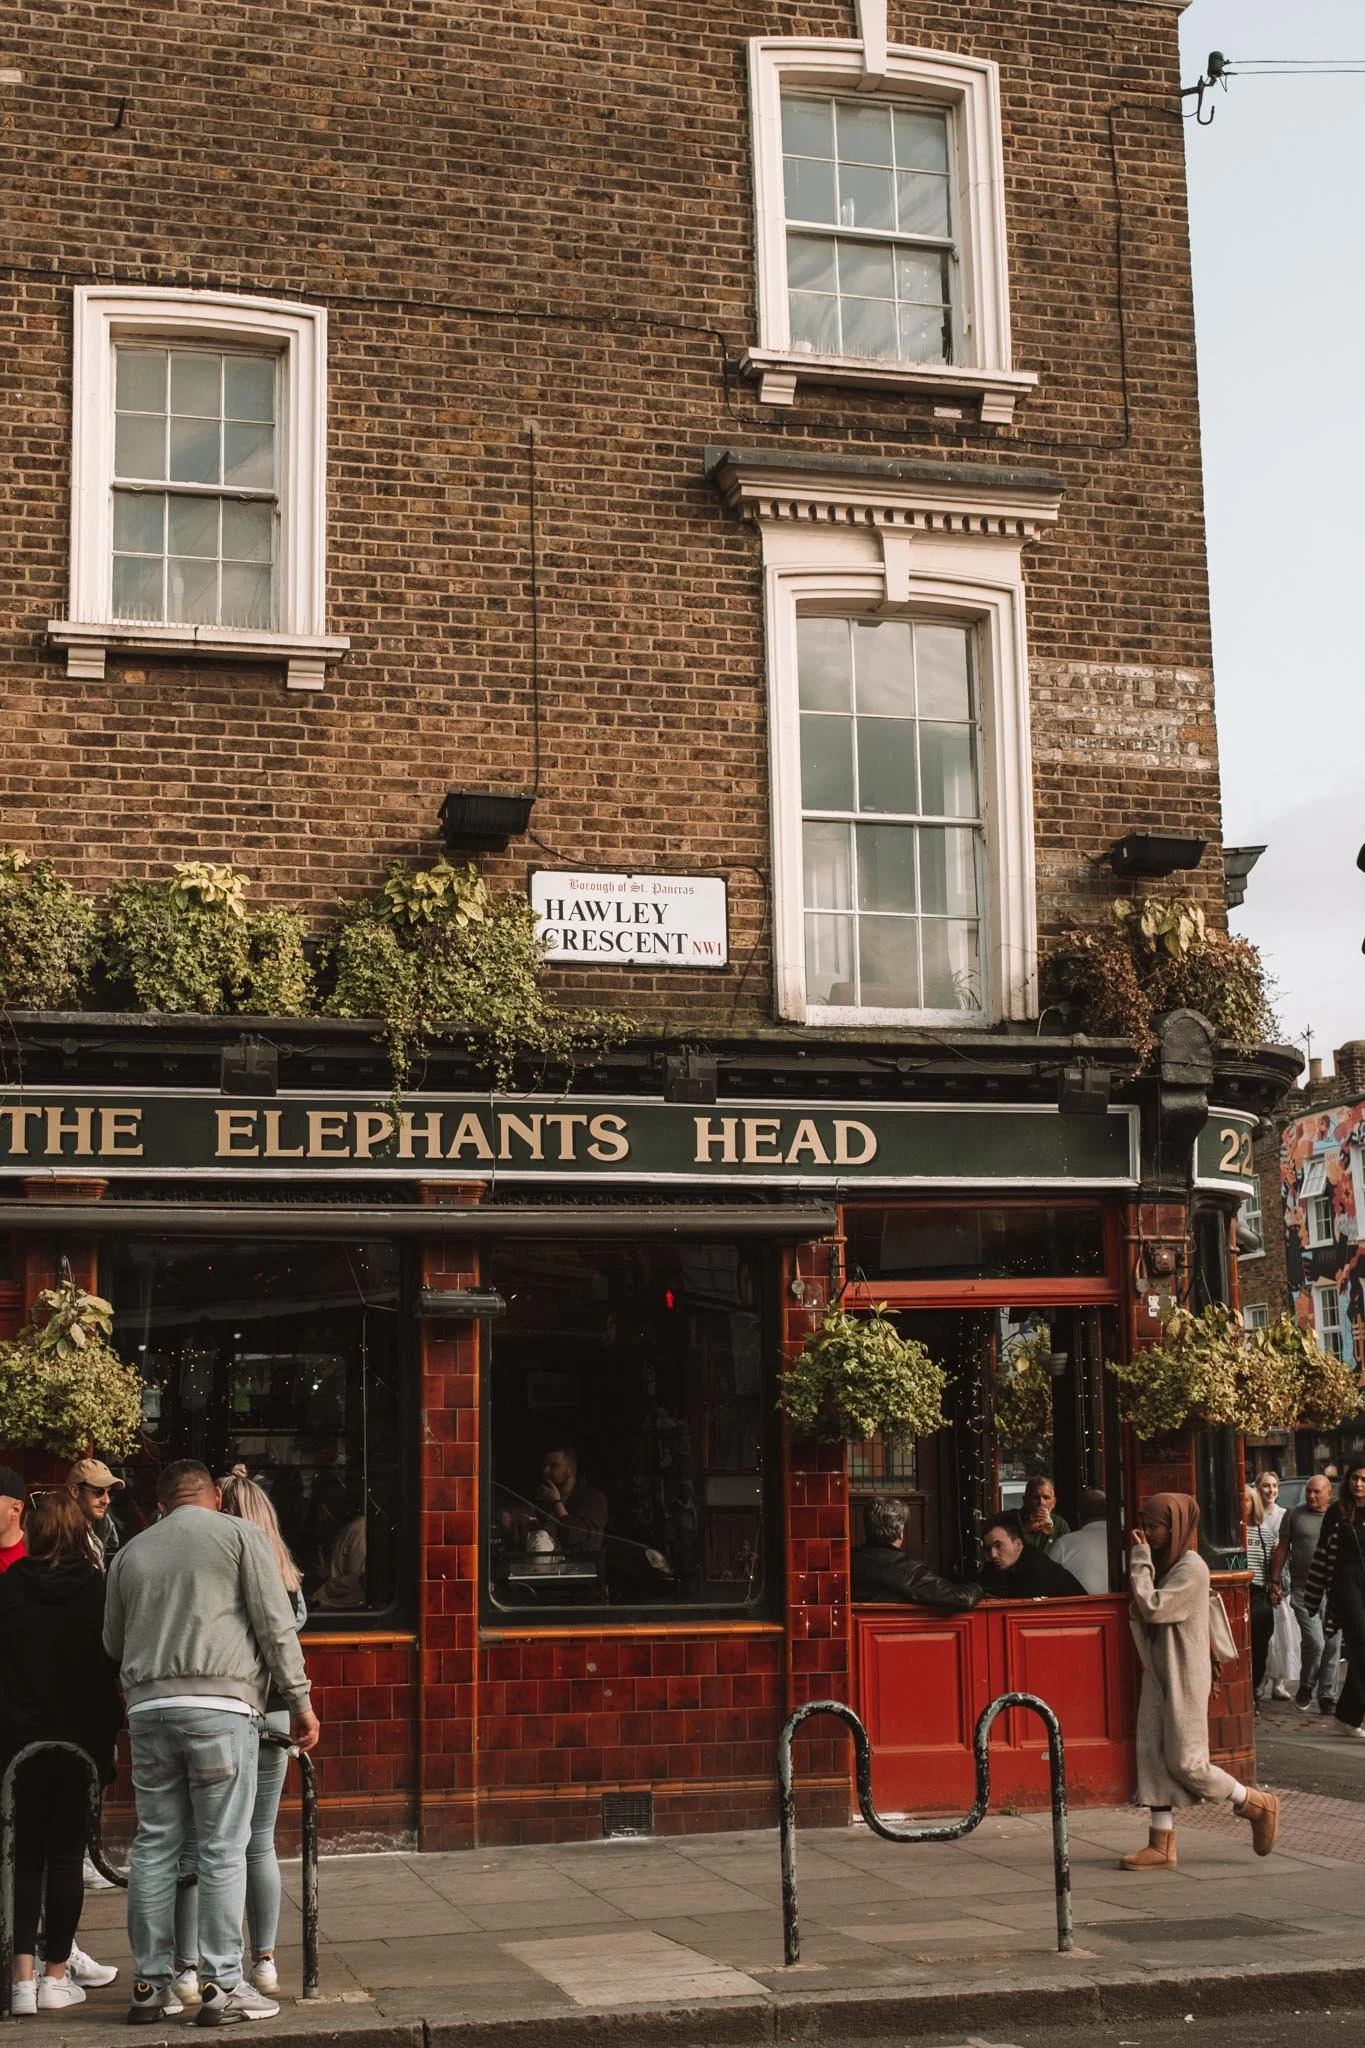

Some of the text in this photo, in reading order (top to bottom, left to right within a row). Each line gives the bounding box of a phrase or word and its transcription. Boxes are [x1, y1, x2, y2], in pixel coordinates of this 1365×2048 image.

[569, 879, 695, 895] Borough of St. Pancras
[544, 899, 669, 924] HAWLEY
[542, 928, 722, 956] CRESCENT NW1
[0, 1106, 878, 1165] THE ELEPHANTS HEAD
